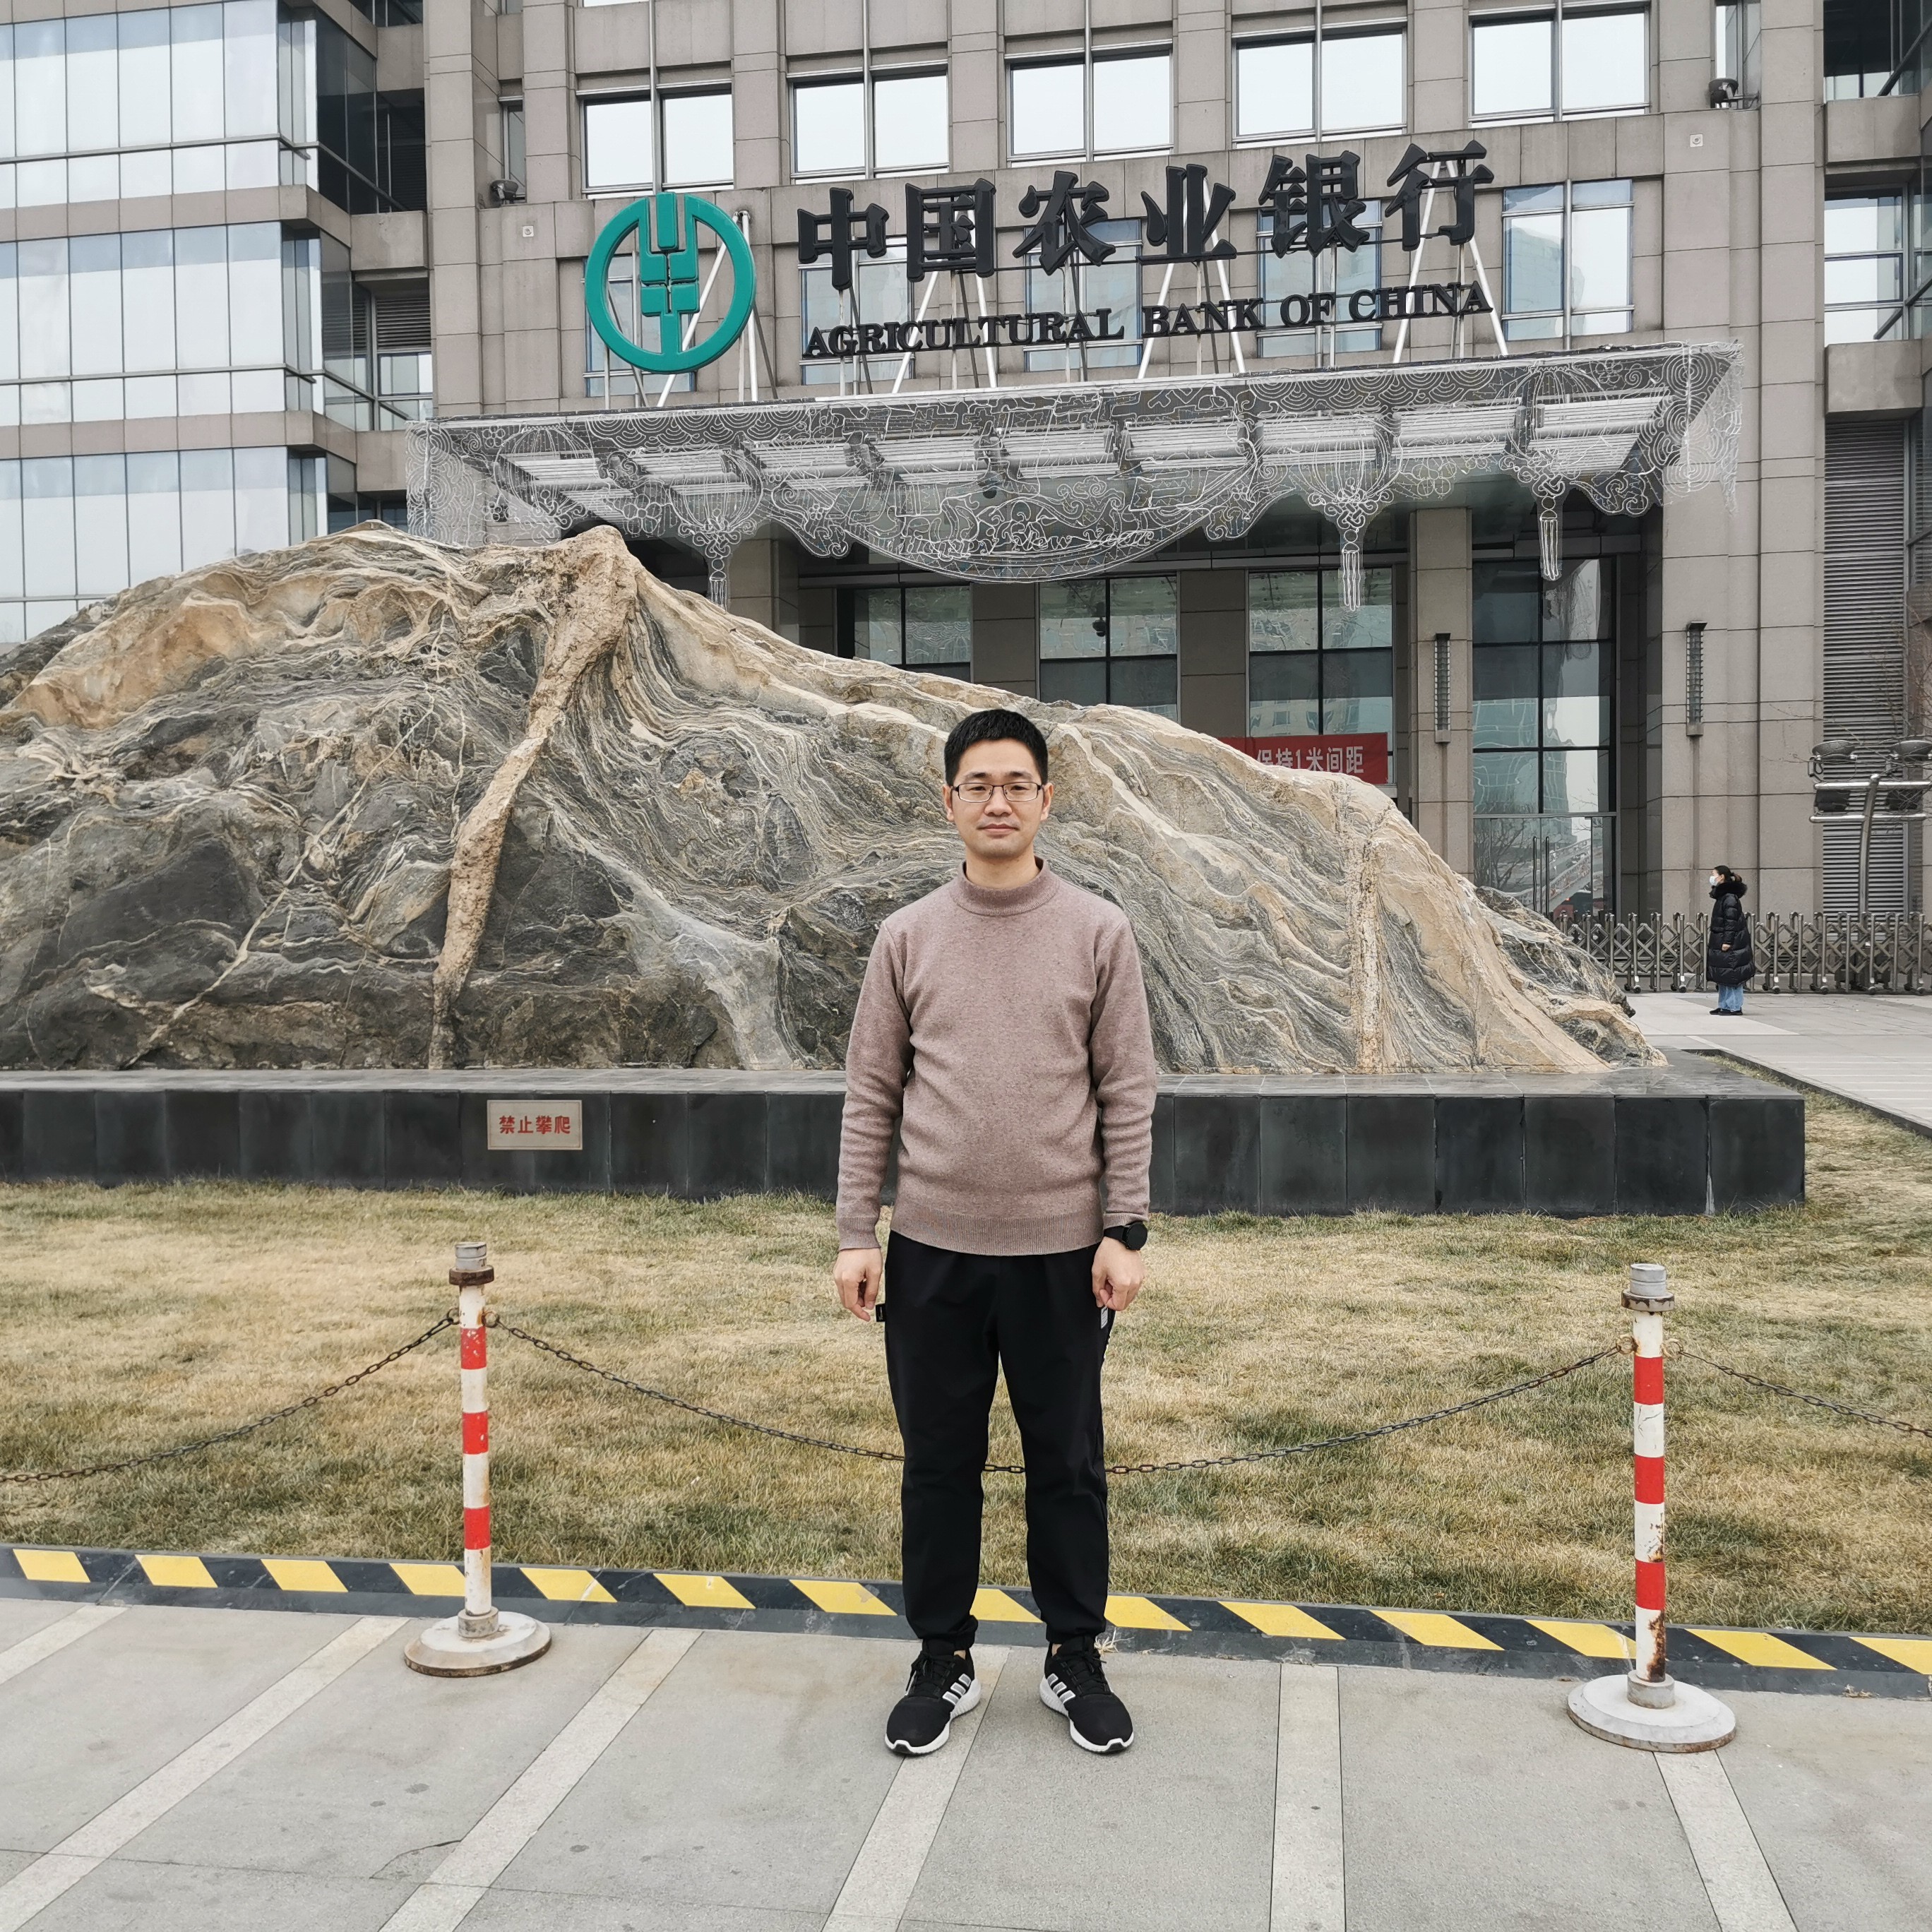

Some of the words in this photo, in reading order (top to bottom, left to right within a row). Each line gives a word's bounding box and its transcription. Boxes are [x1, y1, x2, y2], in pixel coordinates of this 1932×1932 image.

[798, 140, 1493, 290] 中国农业银行
[804, 308, 1124, 359] AGRICULTURAL
[1143, 298, 1266, 338] BANK
[1280, 293, 1337, 328] OF
[1349, 281, 1493, 321] CHINA
[499, 1116, 571, 1134] 禁止攀爬
